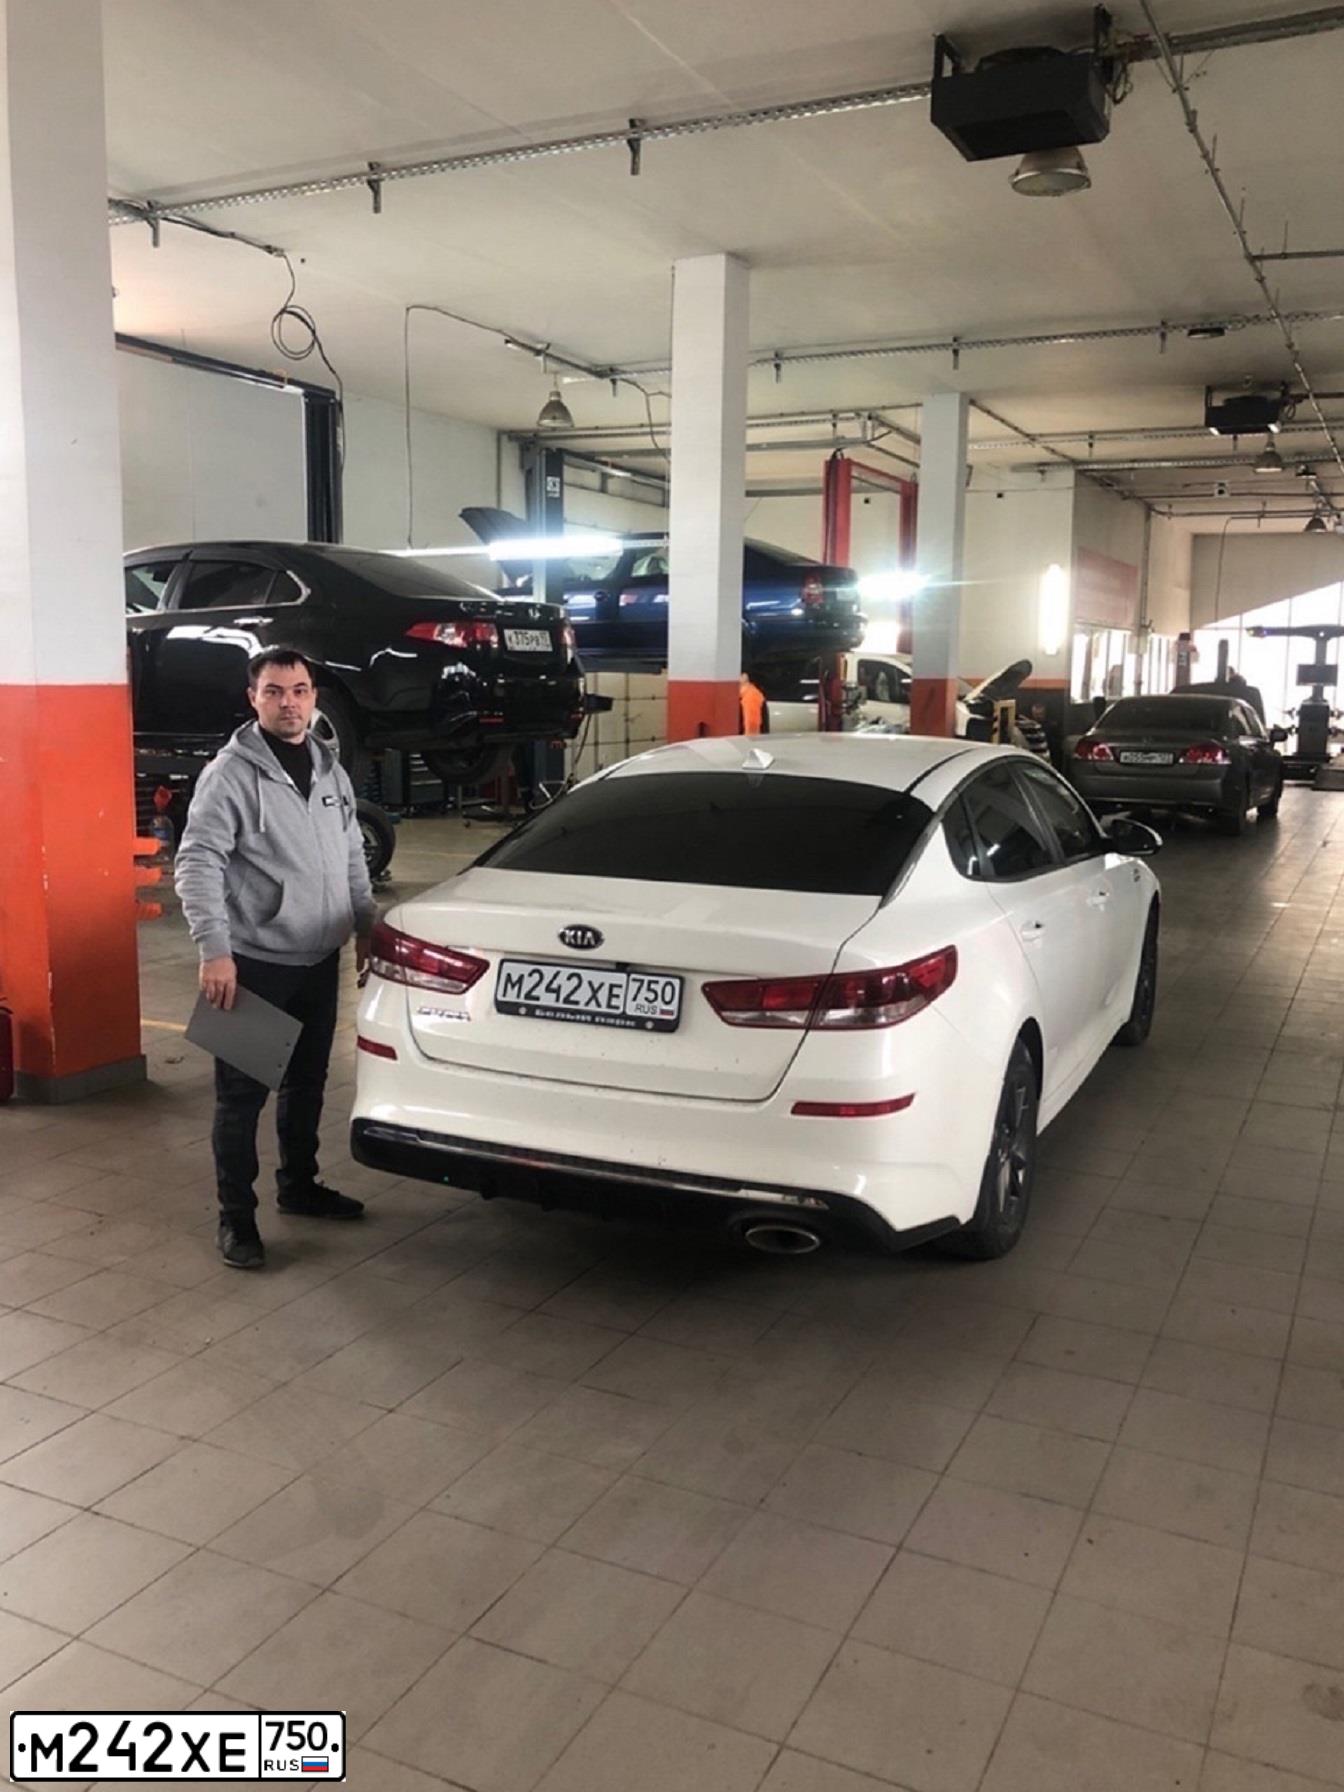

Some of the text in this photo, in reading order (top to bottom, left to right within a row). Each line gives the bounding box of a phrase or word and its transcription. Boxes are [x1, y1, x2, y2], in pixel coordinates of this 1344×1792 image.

[564, 930, 597, 946] KIA
[631, 977, 676, 1005] 750
[634, 1004, 657, 1016] RUS
